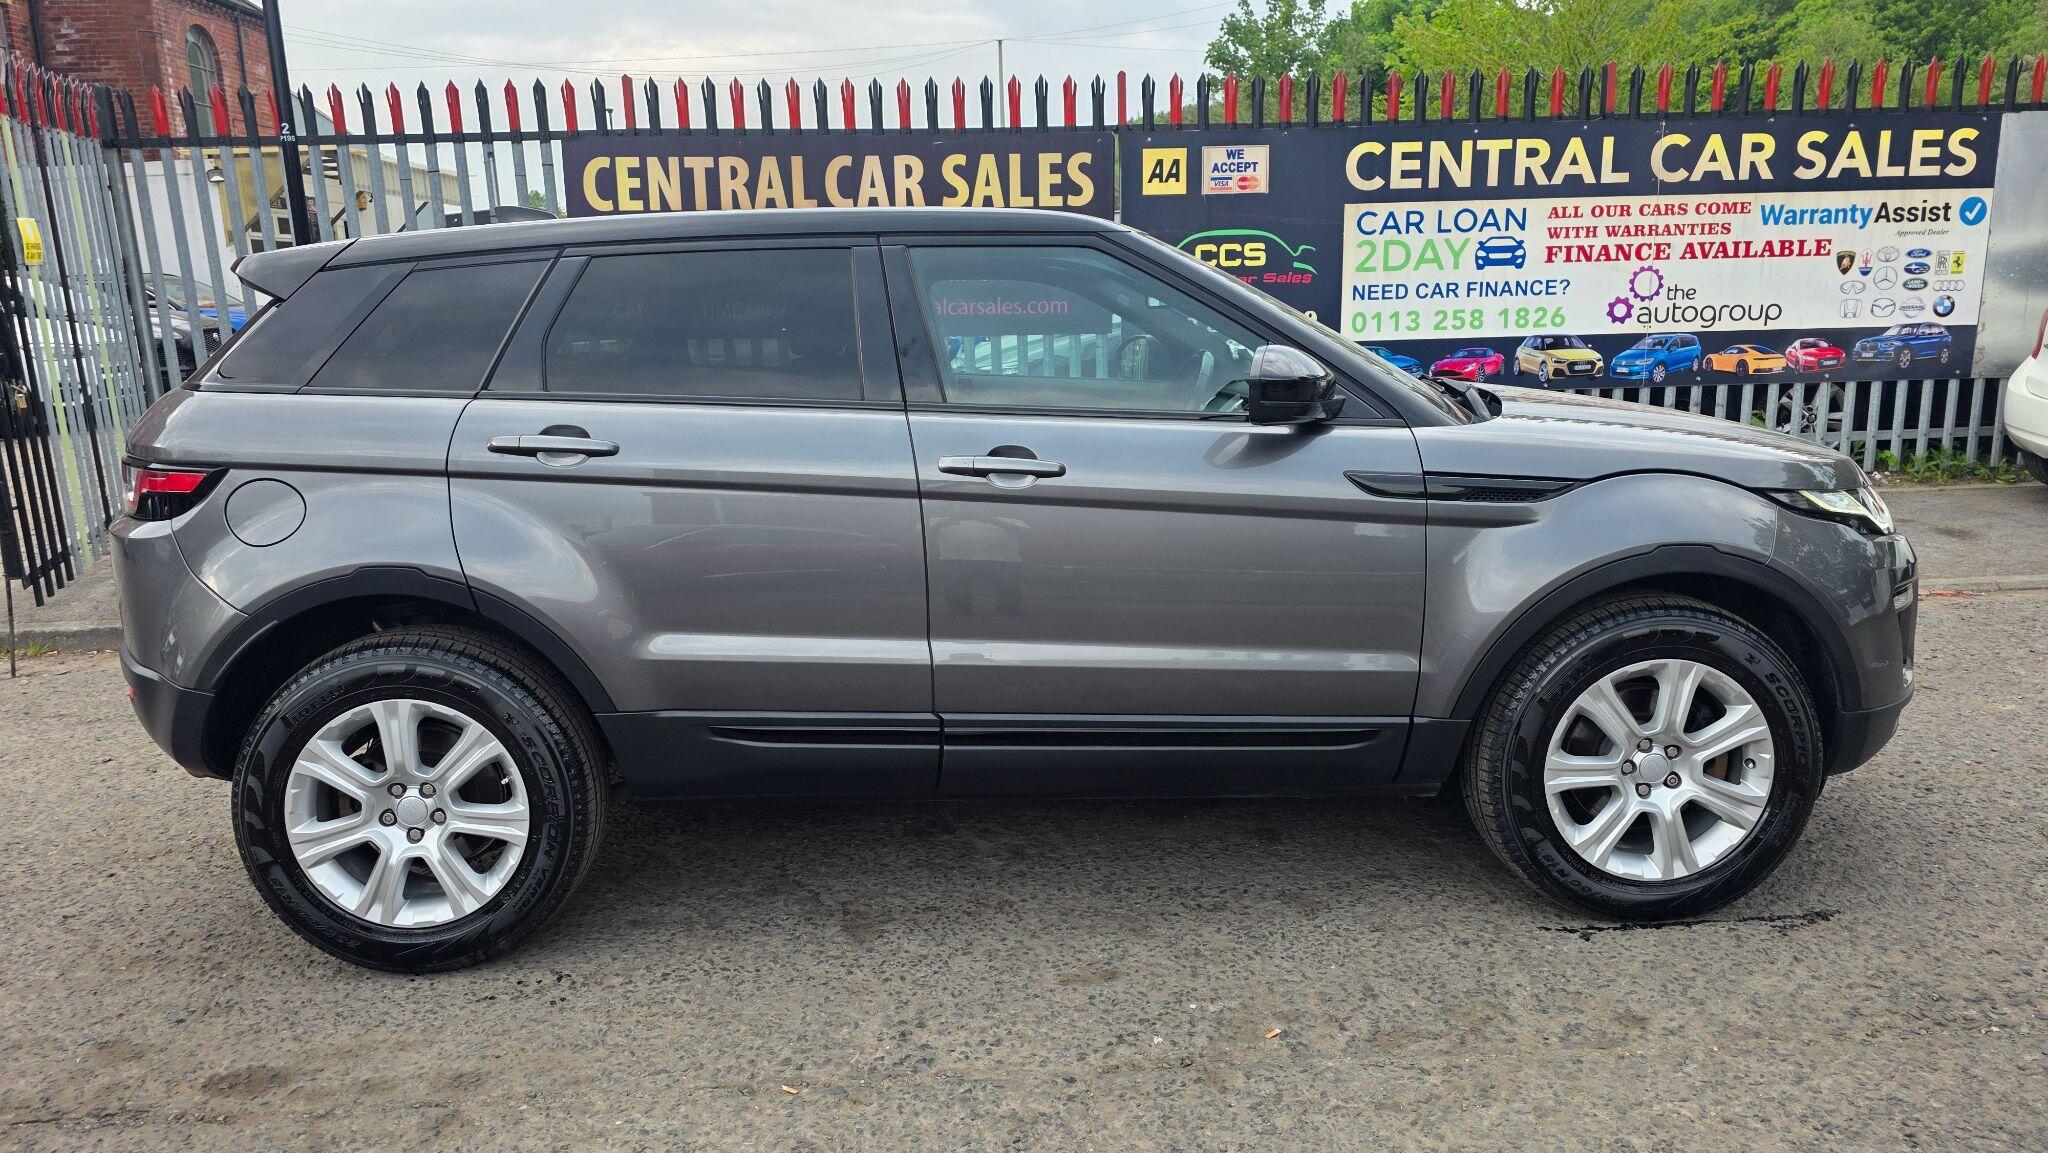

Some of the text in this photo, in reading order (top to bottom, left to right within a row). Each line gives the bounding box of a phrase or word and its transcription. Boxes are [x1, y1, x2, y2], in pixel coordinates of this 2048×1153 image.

[280, 122, 290, 135] 2
[1226, 149, 1244, 160] WE
[1346, 127, 1980, 191] CENTRAL CAR SALES
[1147, 158, 1180, 184] AA
[1211, 162, 1258, 173] ACCEPT
[583, 151, 1095, 212] CENTRAL CAR SALES
[1356, 207, 1527, 236] CAR LOAN
[1547, 201, 1752, 219] ALL OUR CARS COME
[1547, 222, 1732, 239] WITH WARRANTIES
[1895, 229, 1926, 238] Approved
[1194, 242, 1267, 267] CCS
[1354, 237, 1472, 273] 2DAY
[1545, 238, 1832, 263] FINANCE AVAILABLE
[1263, 272, 1312, 284] Sales
[1352, 279, 1571, 301] NEED CAR FINANCE?
[1667, 284, 1697, 301] the
[1352, 306, 1566, 334] 0113 258 1826
[1636, 302, 1783, 328] autogroup
